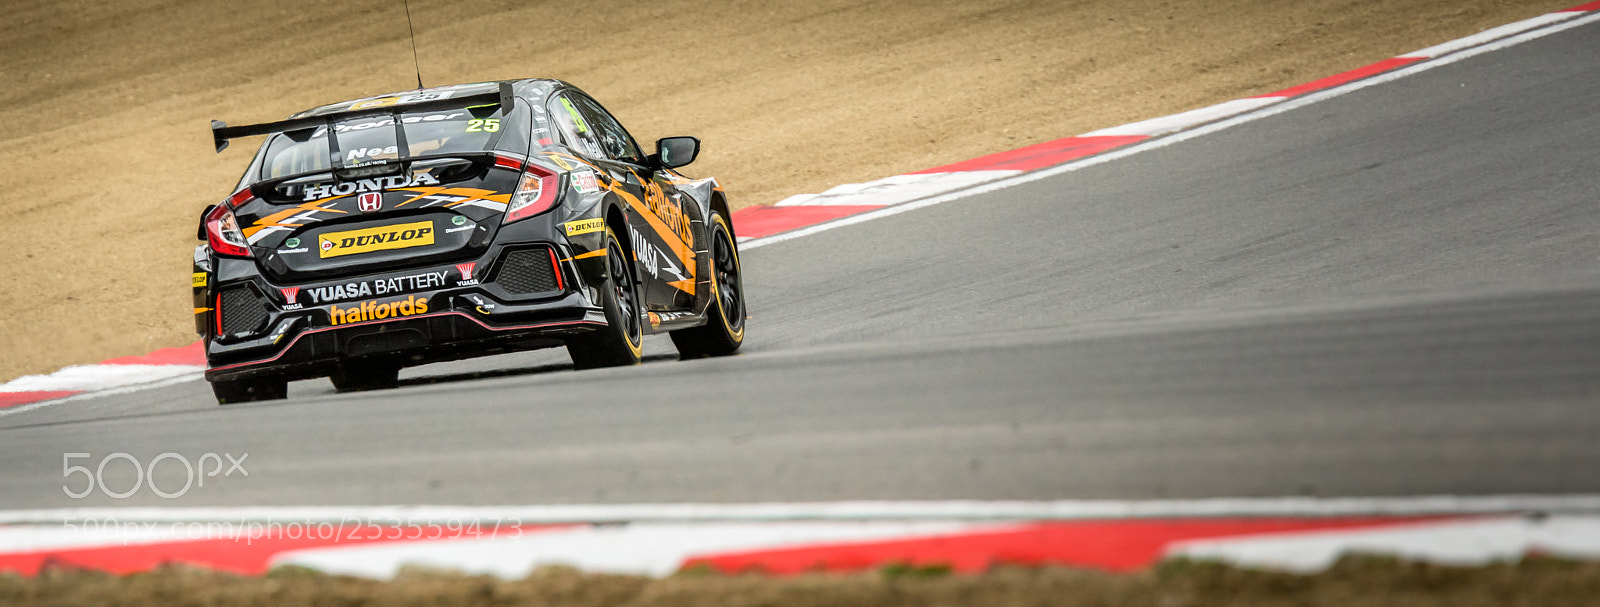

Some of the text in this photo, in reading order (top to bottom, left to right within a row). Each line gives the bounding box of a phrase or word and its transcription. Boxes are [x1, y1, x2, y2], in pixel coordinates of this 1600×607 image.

[465, 118, 500, 133] 25
[346, 145, 399, 161] Nea
[303, 171, 440, 202] HONDA
[575, 221, 604, 231] DUNLOP
[339, 227, 432, 249] DUNLOP
[627, 223, 658, 280] YUASA
[307, 270, 448, 304] YUASA BATTERY
[456, 278, 479, 287] YUASA
[281, 302, 303, 311] YUASA
[330, 295, 428, 326] halfords
